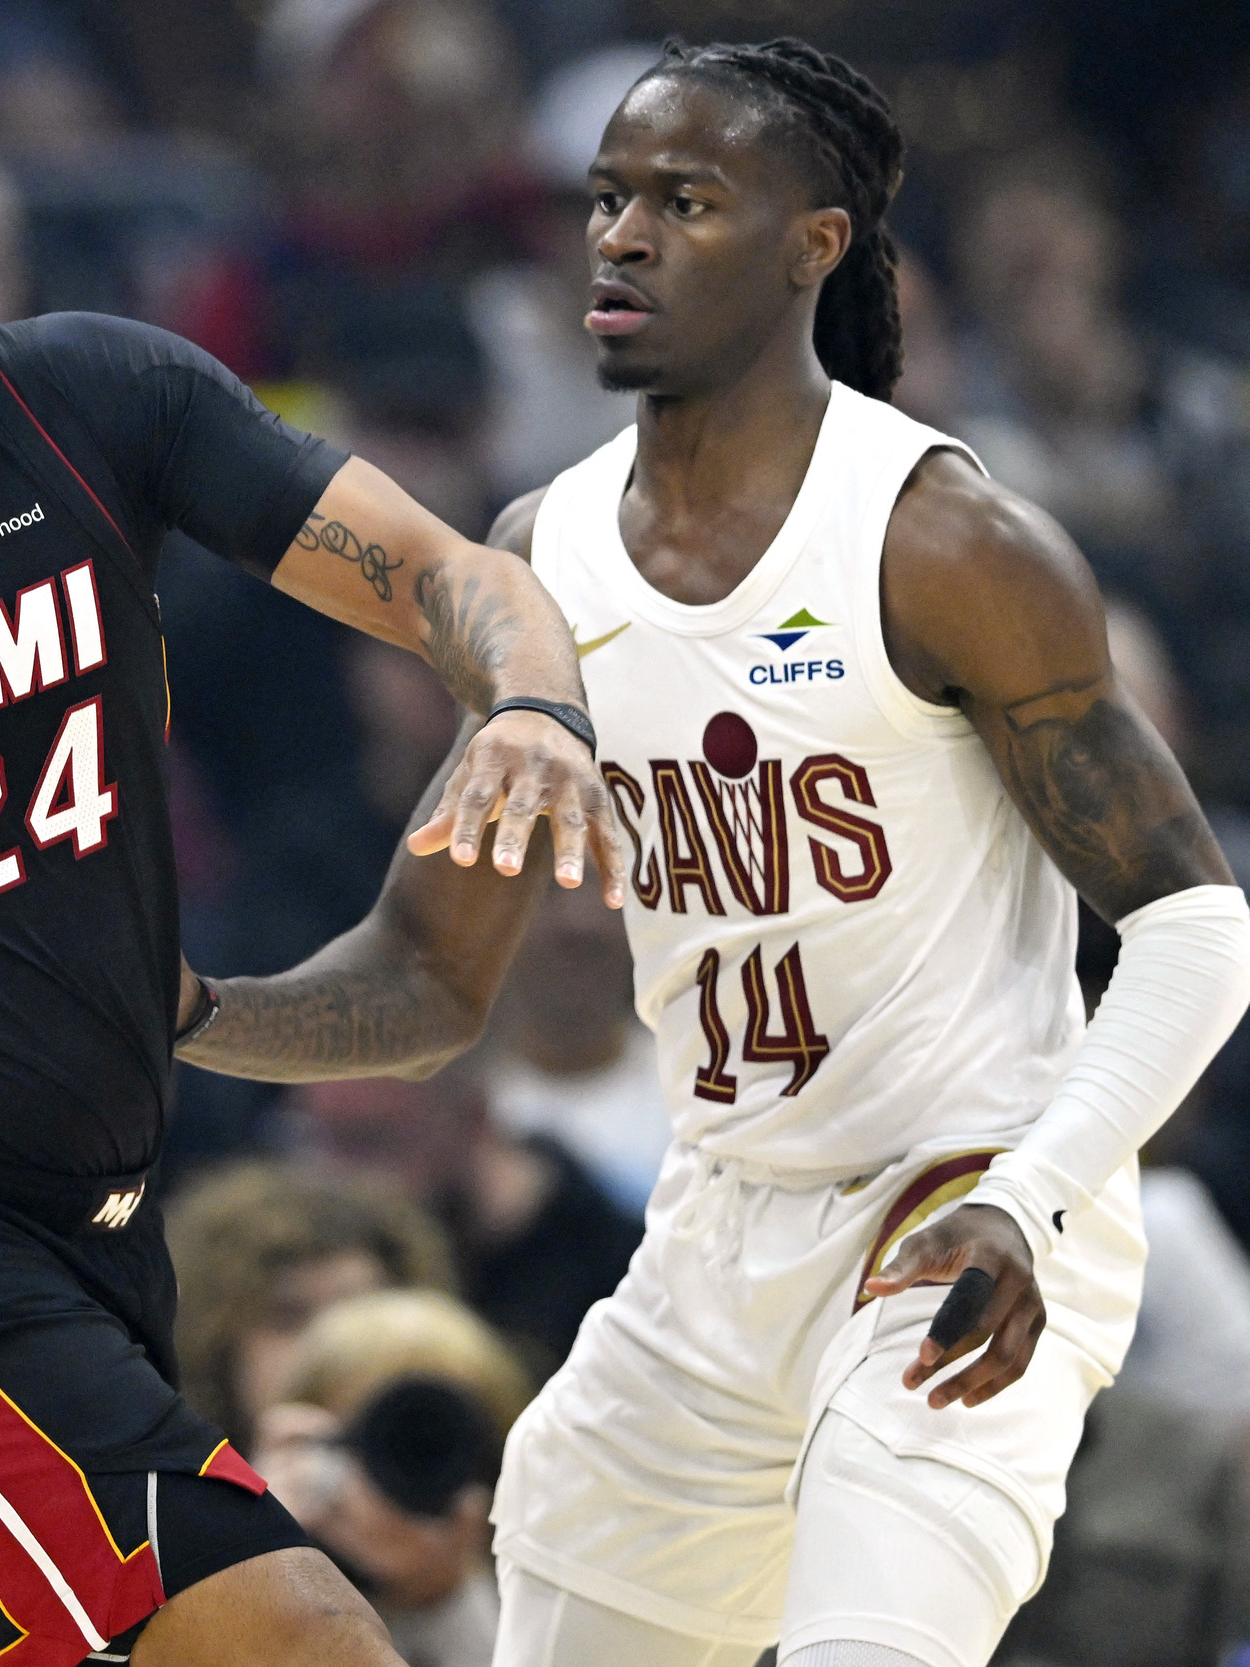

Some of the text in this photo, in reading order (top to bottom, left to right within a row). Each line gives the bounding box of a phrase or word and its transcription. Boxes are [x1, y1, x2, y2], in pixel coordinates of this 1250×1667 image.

[749, 659, 845, 685] CLIFFS
[600, 752, 892, 917] CAVS
[694, 941, 830, 1105] 14
